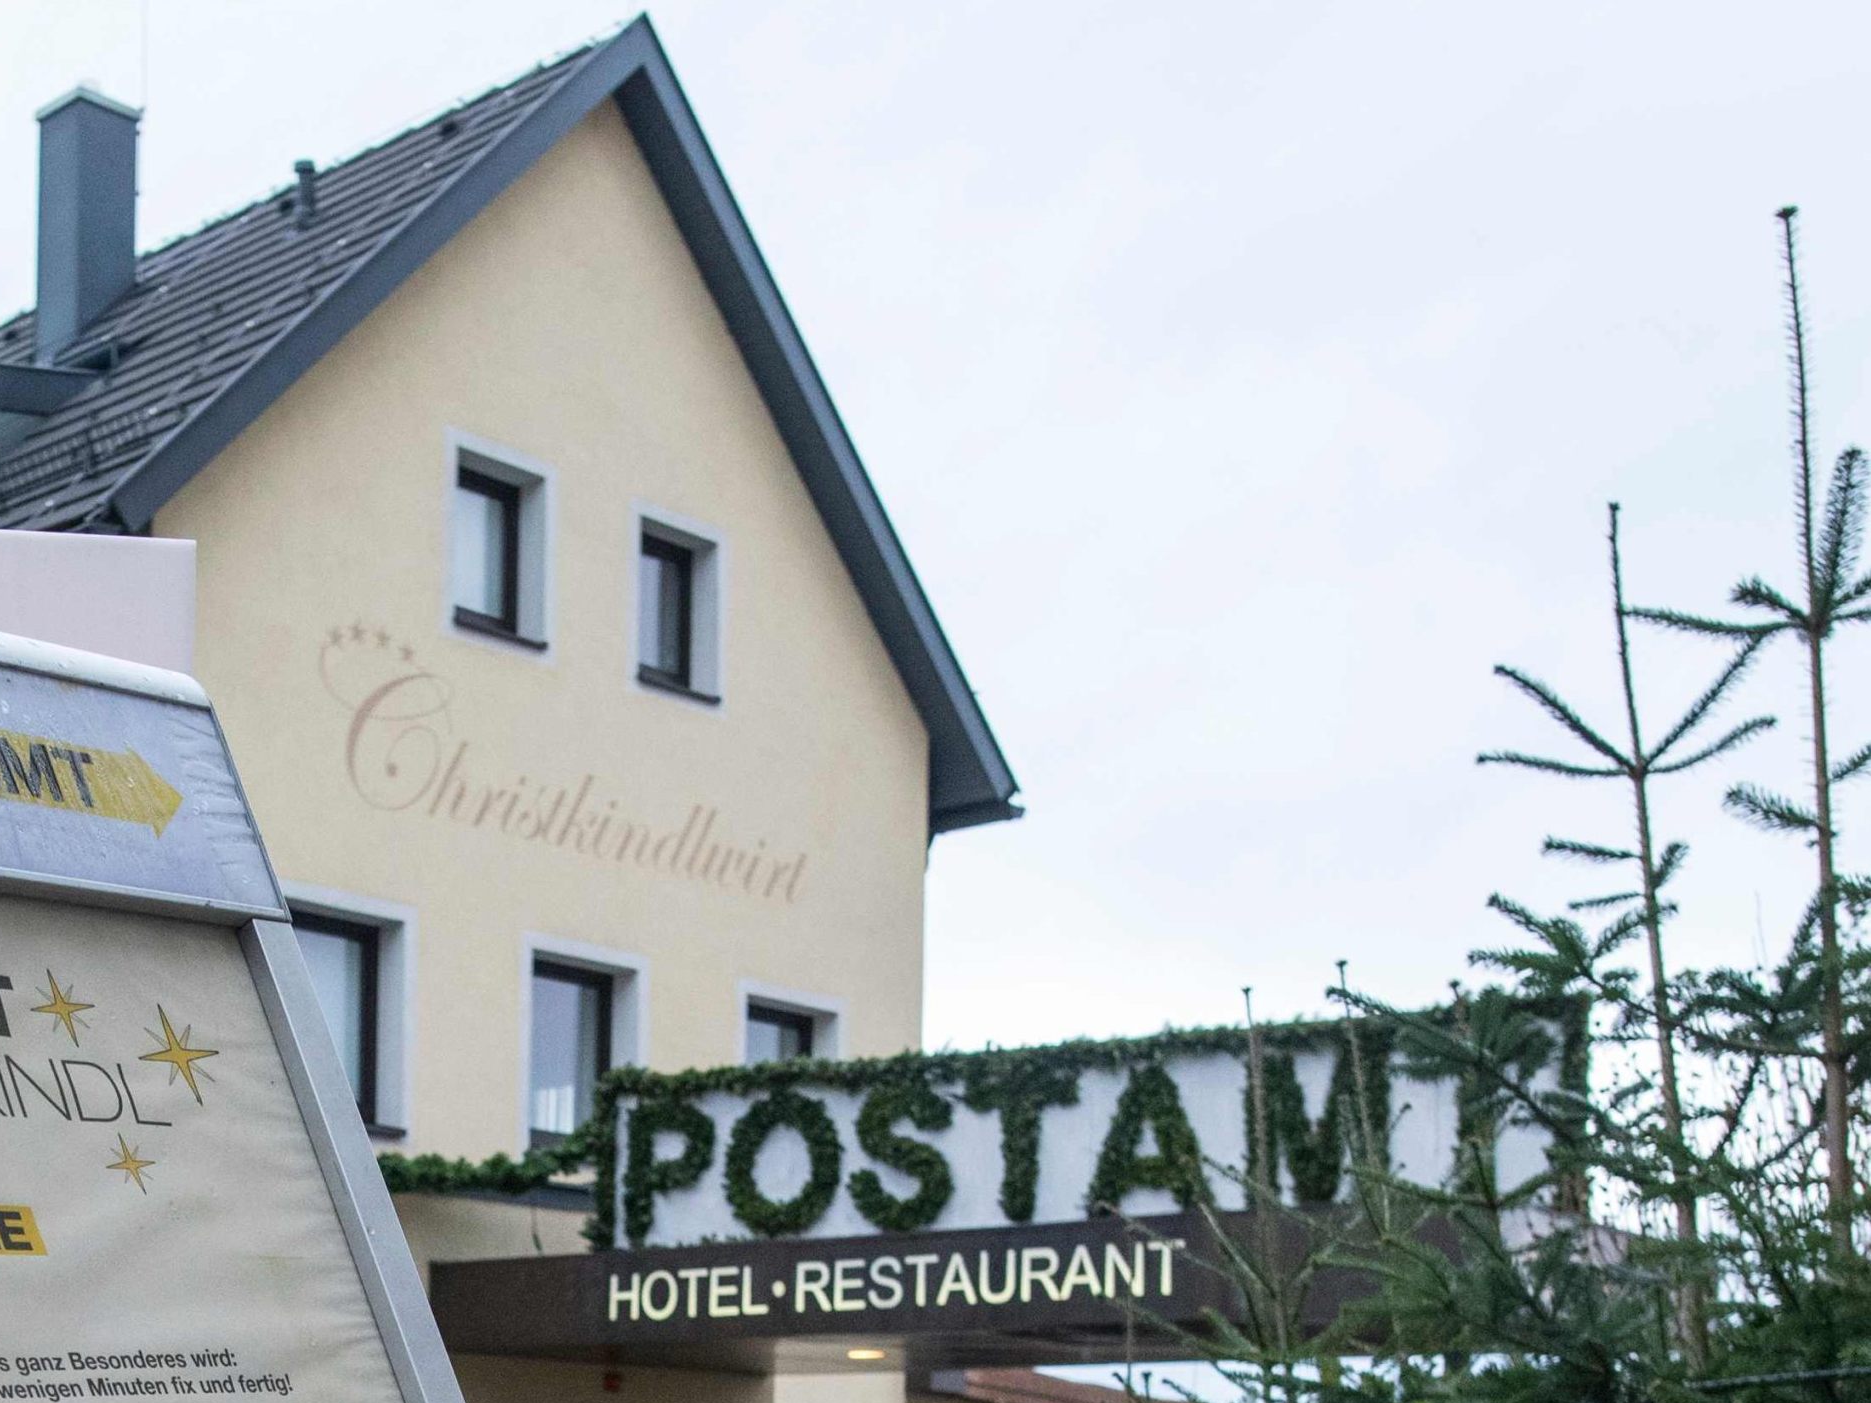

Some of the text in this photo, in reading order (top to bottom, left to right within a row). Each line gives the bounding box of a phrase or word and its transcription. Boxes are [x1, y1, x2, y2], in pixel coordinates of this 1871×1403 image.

[318, 641, 808, 902] Christkindlwirt
[15, 1357, 65, 1376] ganz
[68, 1350, 187, 1370] Besonderes
[190, 1349, 237, 1367] wird:
[87, 1378, 168, 1396] Minuten
[171, 1376, 196, 1394] fix
[199, 1375, 235, 1393] und
[238, 1374, 293, 1396] fertig!
